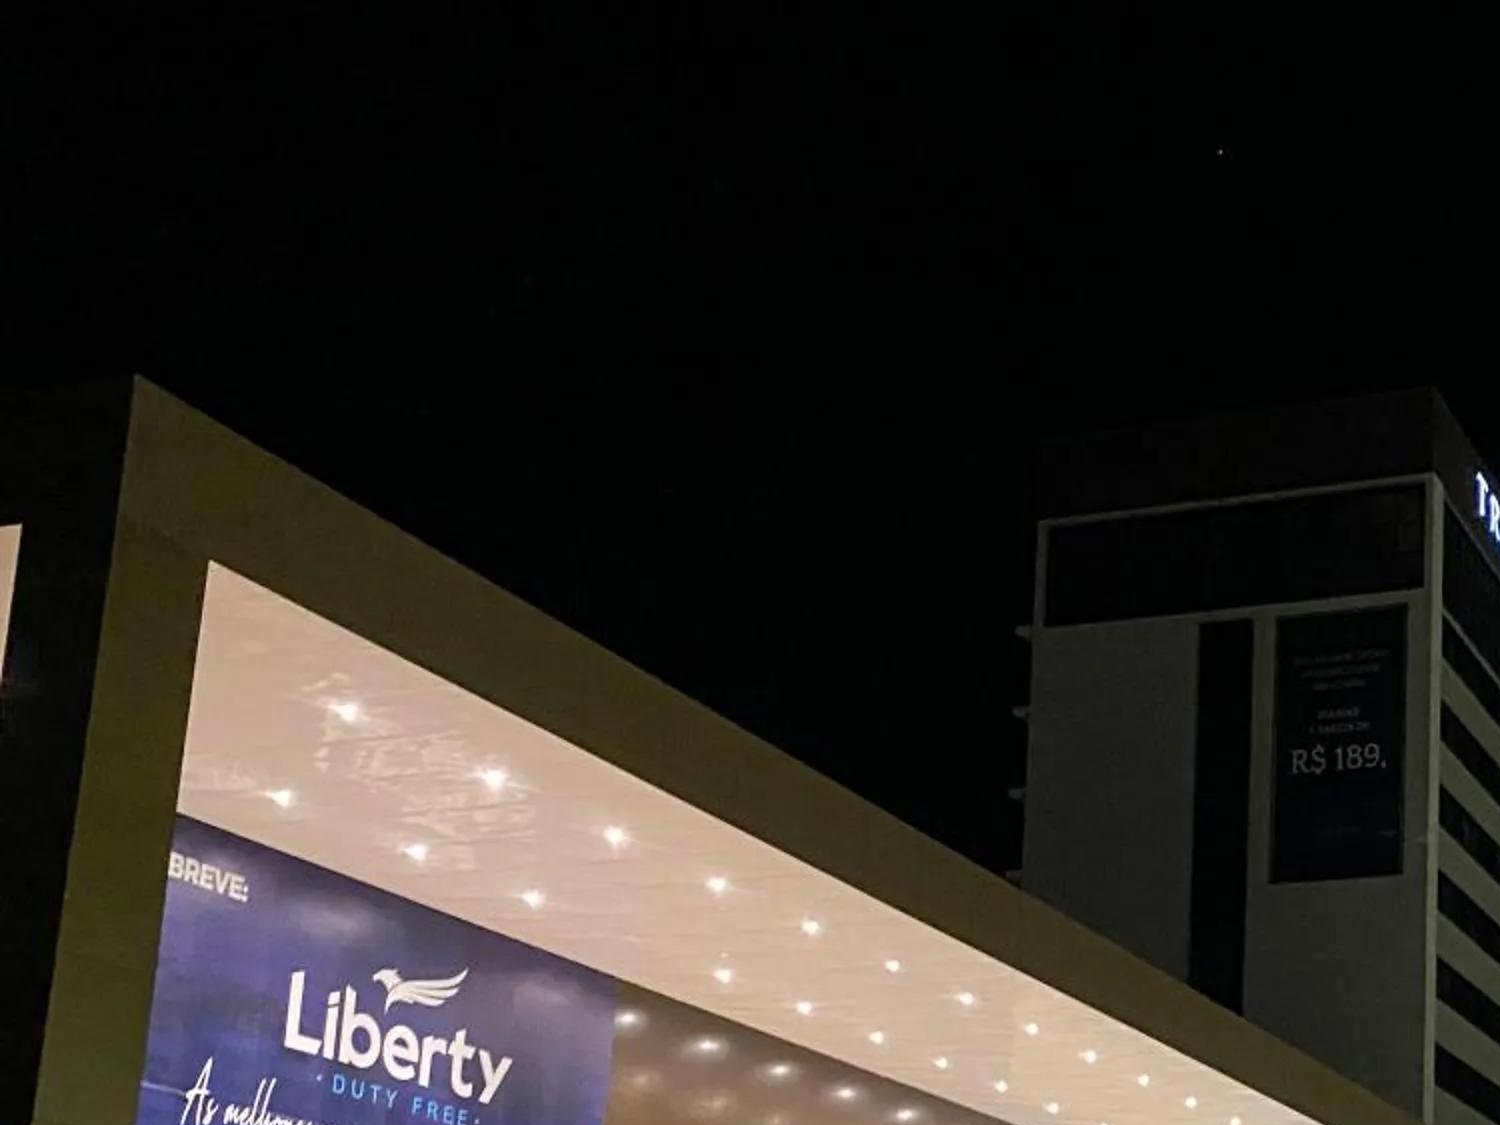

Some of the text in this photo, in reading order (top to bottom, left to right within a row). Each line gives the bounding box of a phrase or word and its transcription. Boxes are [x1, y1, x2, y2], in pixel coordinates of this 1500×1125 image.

[1290, 743, 1327, 775] R$
[168, 850, 249, 902] BREVE:
[284, 970, 513, 1105] Liberty
[332, 1073, 399, 1109] DUTY
